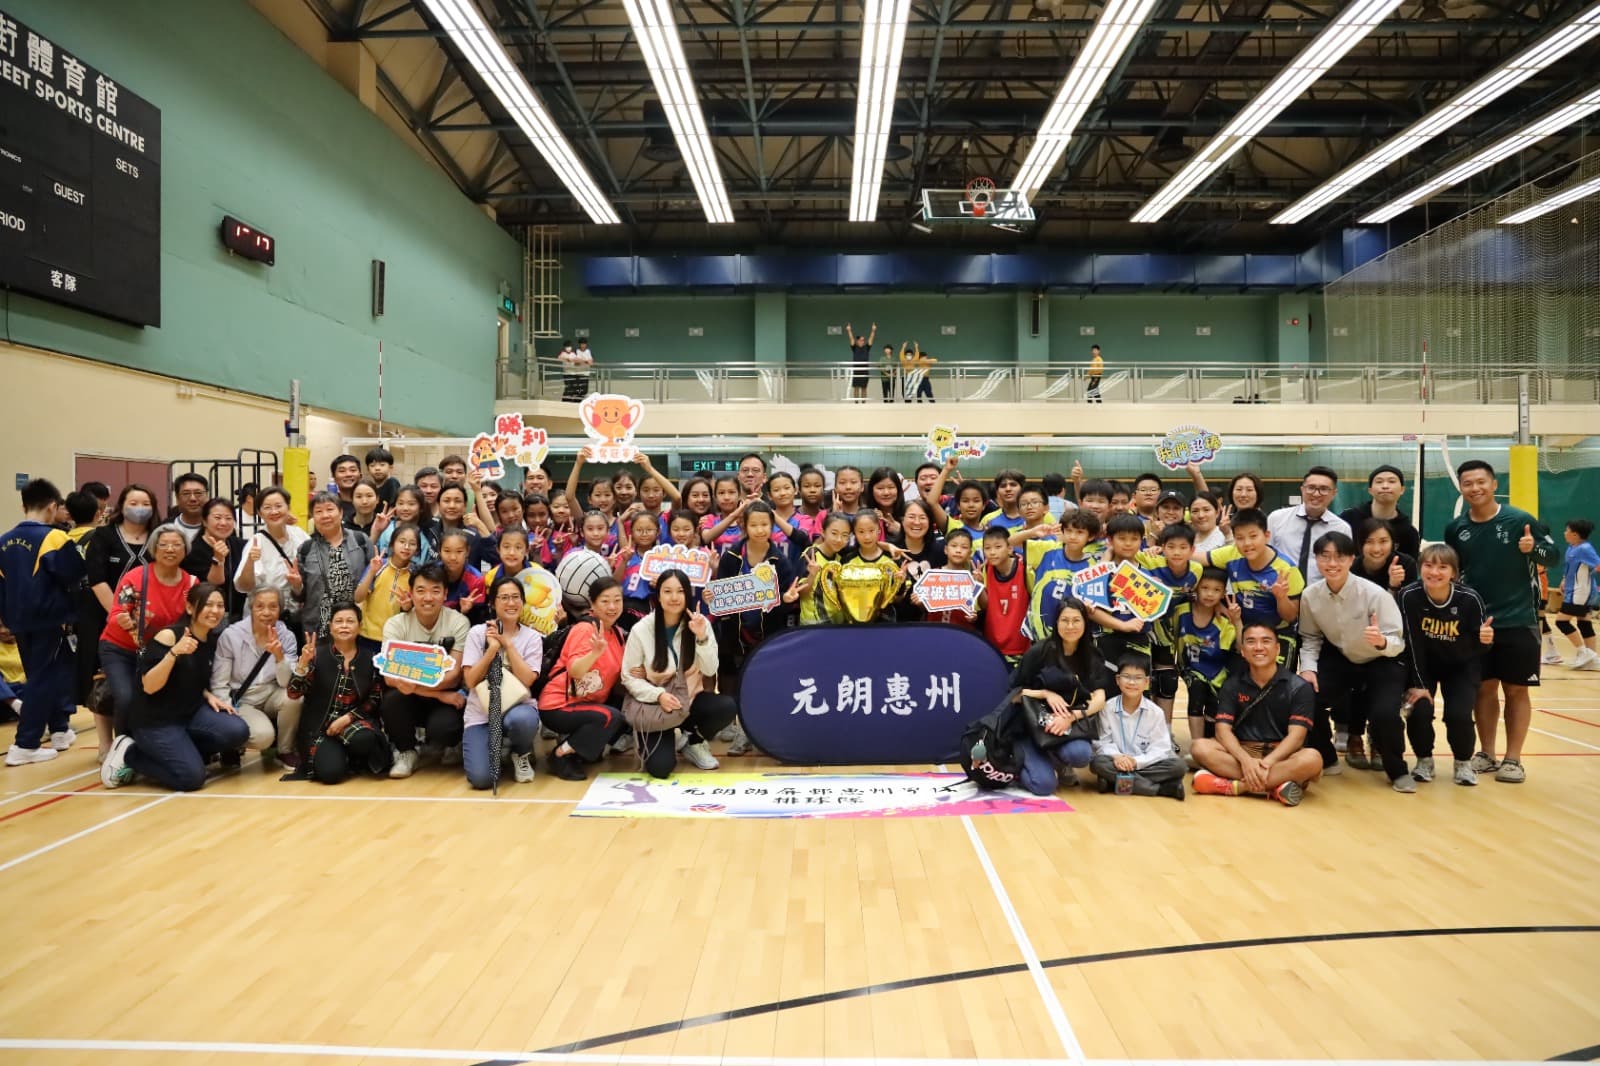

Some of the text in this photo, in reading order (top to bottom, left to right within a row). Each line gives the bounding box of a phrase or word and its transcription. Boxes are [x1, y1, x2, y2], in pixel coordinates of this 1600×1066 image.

[35, 75, 93, 124] SPORTS
[97, 113, 145, 152] CENTRE
[115, 157, 139, 178] SETS
[53, 182, 85, 205] GUEST
[51, 269, 77, 292] 客隊
[693, 461, 716, 471] EXIT
[1077, 564, 1109, 583] TEAM
[1000, 599, 1009, 615] 7
[1421, 617, 1460, 636] CUHK
[790, 672, 961, 716] 元朗惠州
